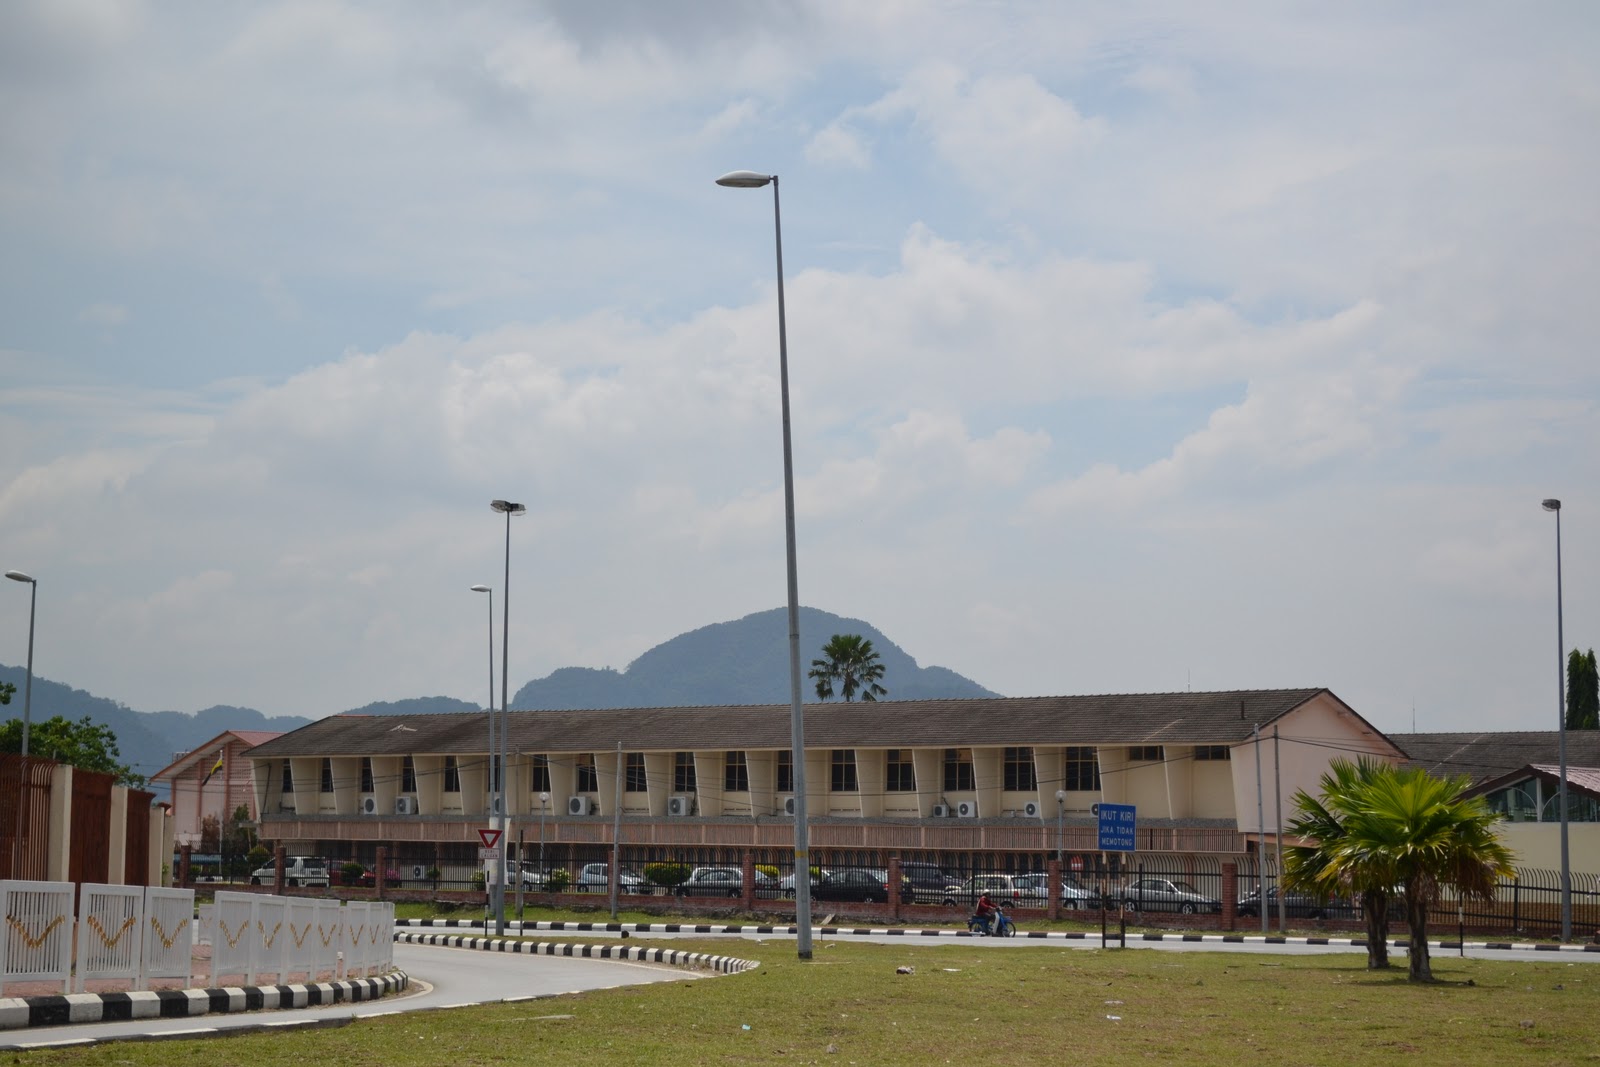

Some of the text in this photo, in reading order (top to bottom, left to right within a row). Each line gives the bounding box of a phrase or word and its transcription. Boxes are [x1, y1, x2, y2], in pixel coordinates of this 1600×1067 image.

[1101, 810, 1134, 822] IKUT KIRI
[1101, 826, 1134, 835] JIKA TIDAK
[1101, 837, 1133, 846] MEMOTONG
